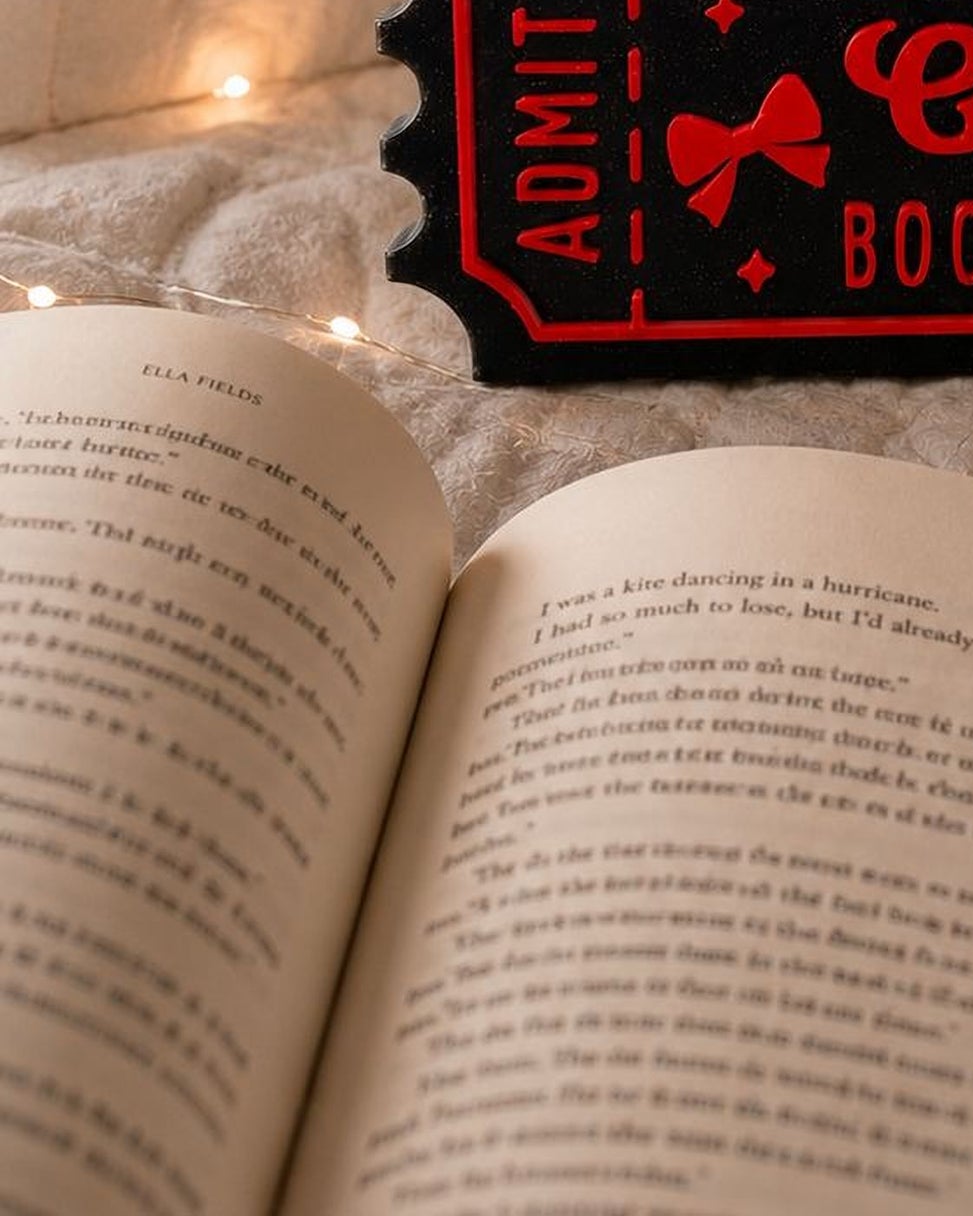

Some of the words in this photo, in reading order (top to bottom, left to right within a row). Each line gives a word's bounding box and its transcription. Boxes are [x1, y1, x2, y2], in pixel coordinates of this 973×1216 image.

[511, 7, 601, 264] ADMIT
[141, 363, 189, 384] ELLA
[196, 374, 264, 407] FIELDS
[540, 602, 549, 617] I
[557, 590, 596, 610] was
[603, 586, 614, 598] a
[672, 570, 764, 589] dancing
[772, 572, 795, 590] in
[802, 577, 815, 591] a
[822, 575, 940, 613] hurricane.
[534, 628, 542, 645] I
[551, 613, 593, 639] had
[600, 610, 626, 626] so
[634, 598, 700, 619] much
[709, 599, 733, 614] to
[741, 597, 793, 619] lose,
[803, 602, 843, 623] but
[851, 609, 884, 631] I'd
